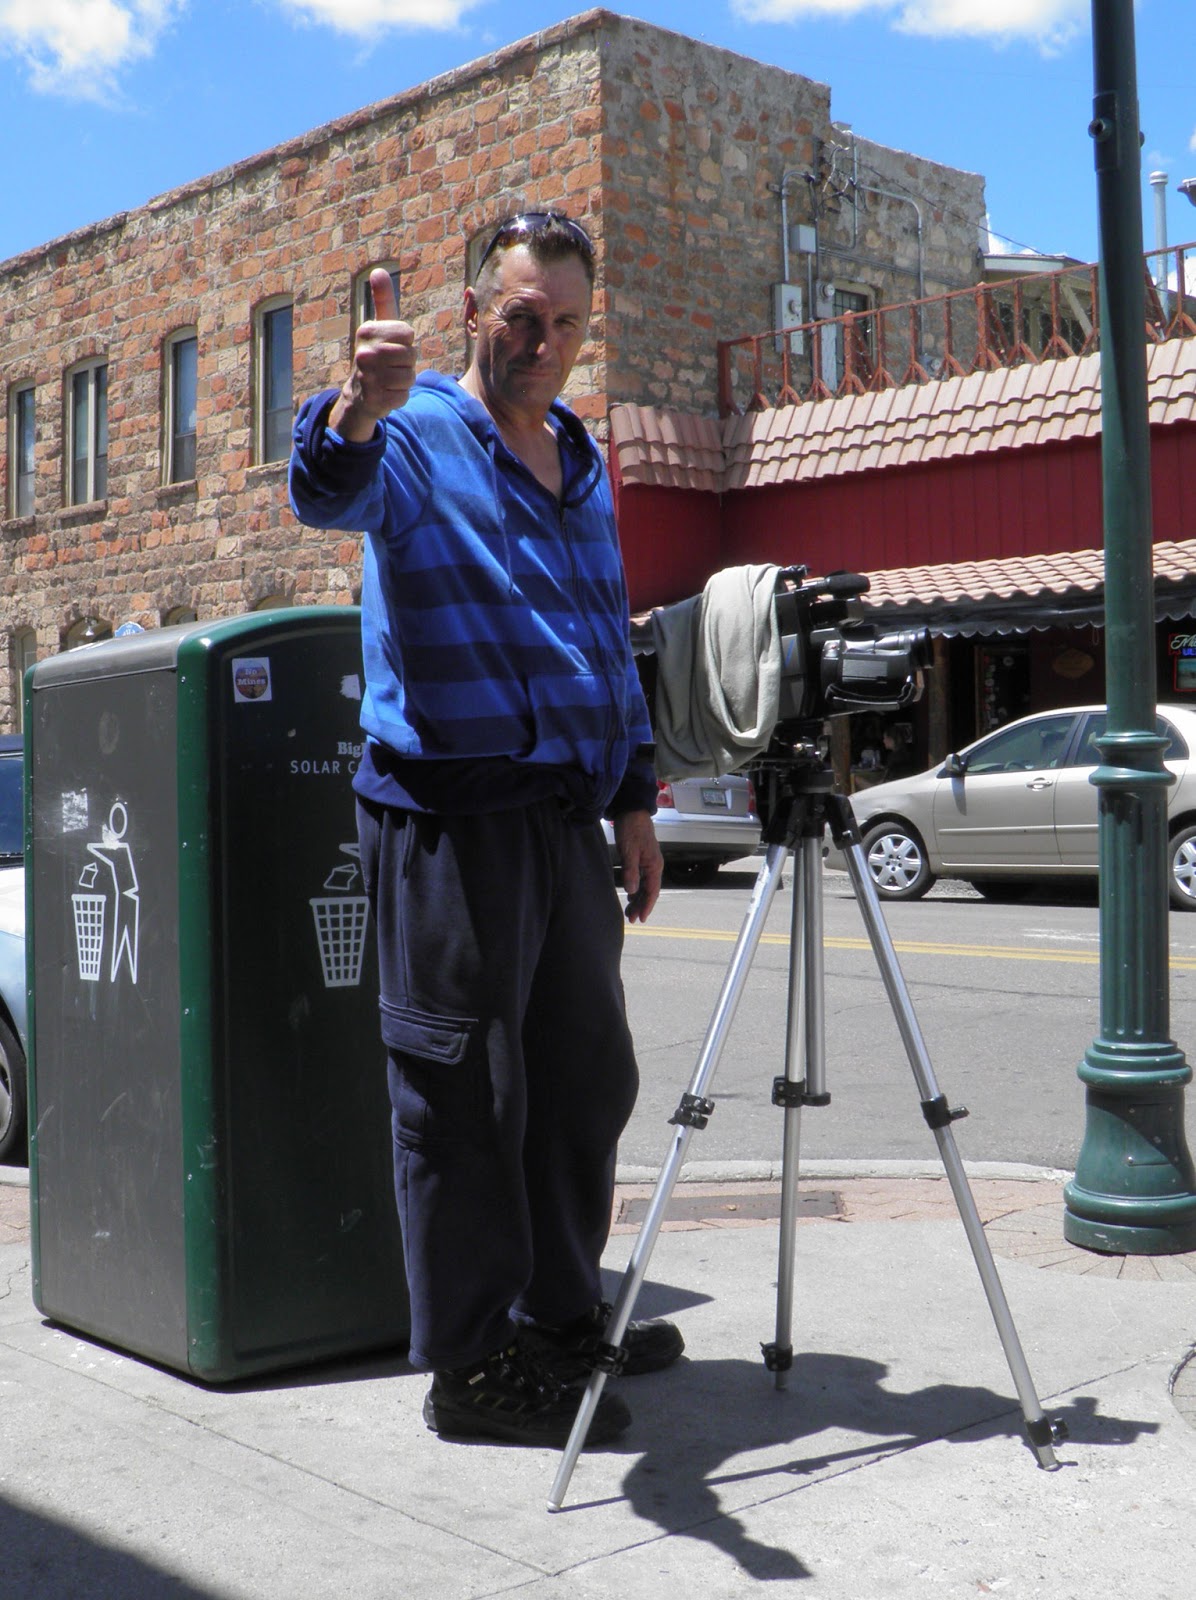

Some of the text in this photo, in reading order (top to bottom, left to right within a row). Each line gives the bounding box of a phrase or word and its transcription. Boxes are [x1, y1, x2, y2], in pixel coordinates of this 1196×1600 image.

[245, 668, 258, 676] No
[237, 677, 266, 686] Mines
[290, 760, 340, 774] SOLAR
